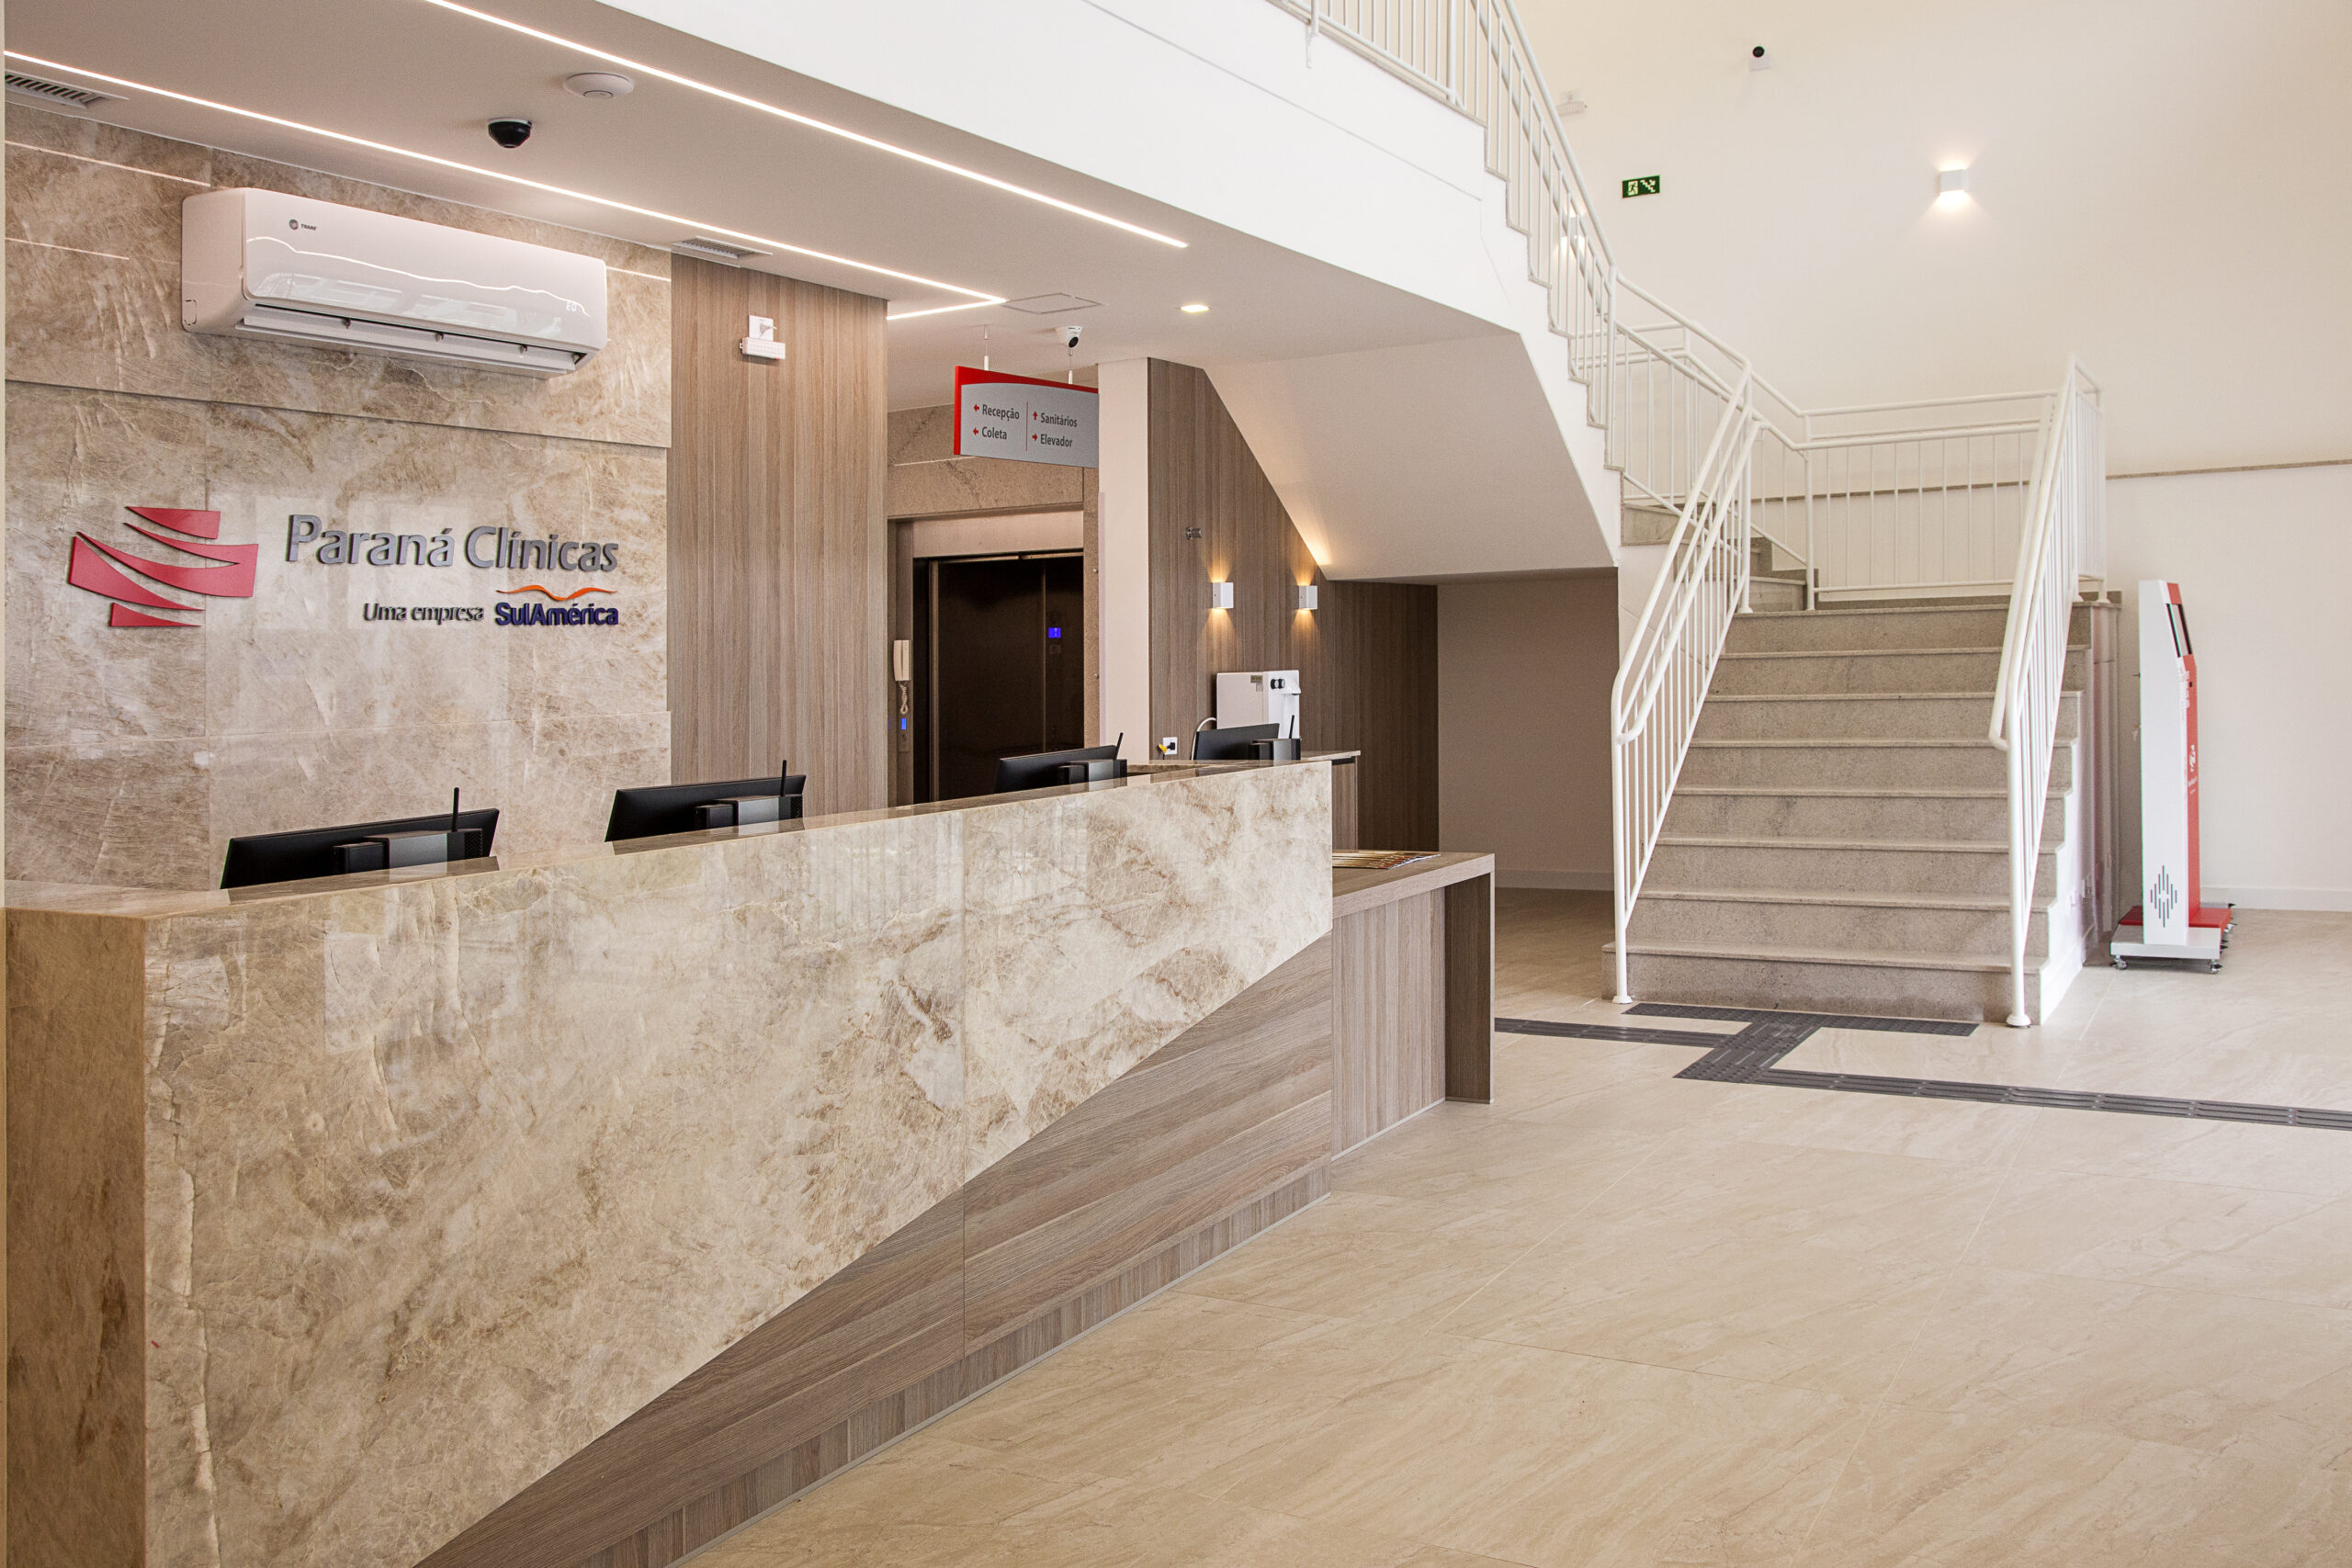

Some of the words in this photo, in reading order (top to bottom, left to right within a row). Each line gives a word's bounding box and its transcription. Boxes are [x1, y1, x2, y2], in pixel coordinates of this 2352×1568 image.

[982, 404, 1020, 422] Recepção
[1040, 412, 1078, 427] Sanitários
[981, 426, 1007, 440] Coleta
[1040, 434, 1072, 447] Elevador
[285, 514, 456, 568] Paraná
[464, 525, 619, 572] Clínicas
[363, 603, 407, 621] Uma
[410, 606, 484, 626] empresa
[494, 601, 619, 626] SulAmérica
